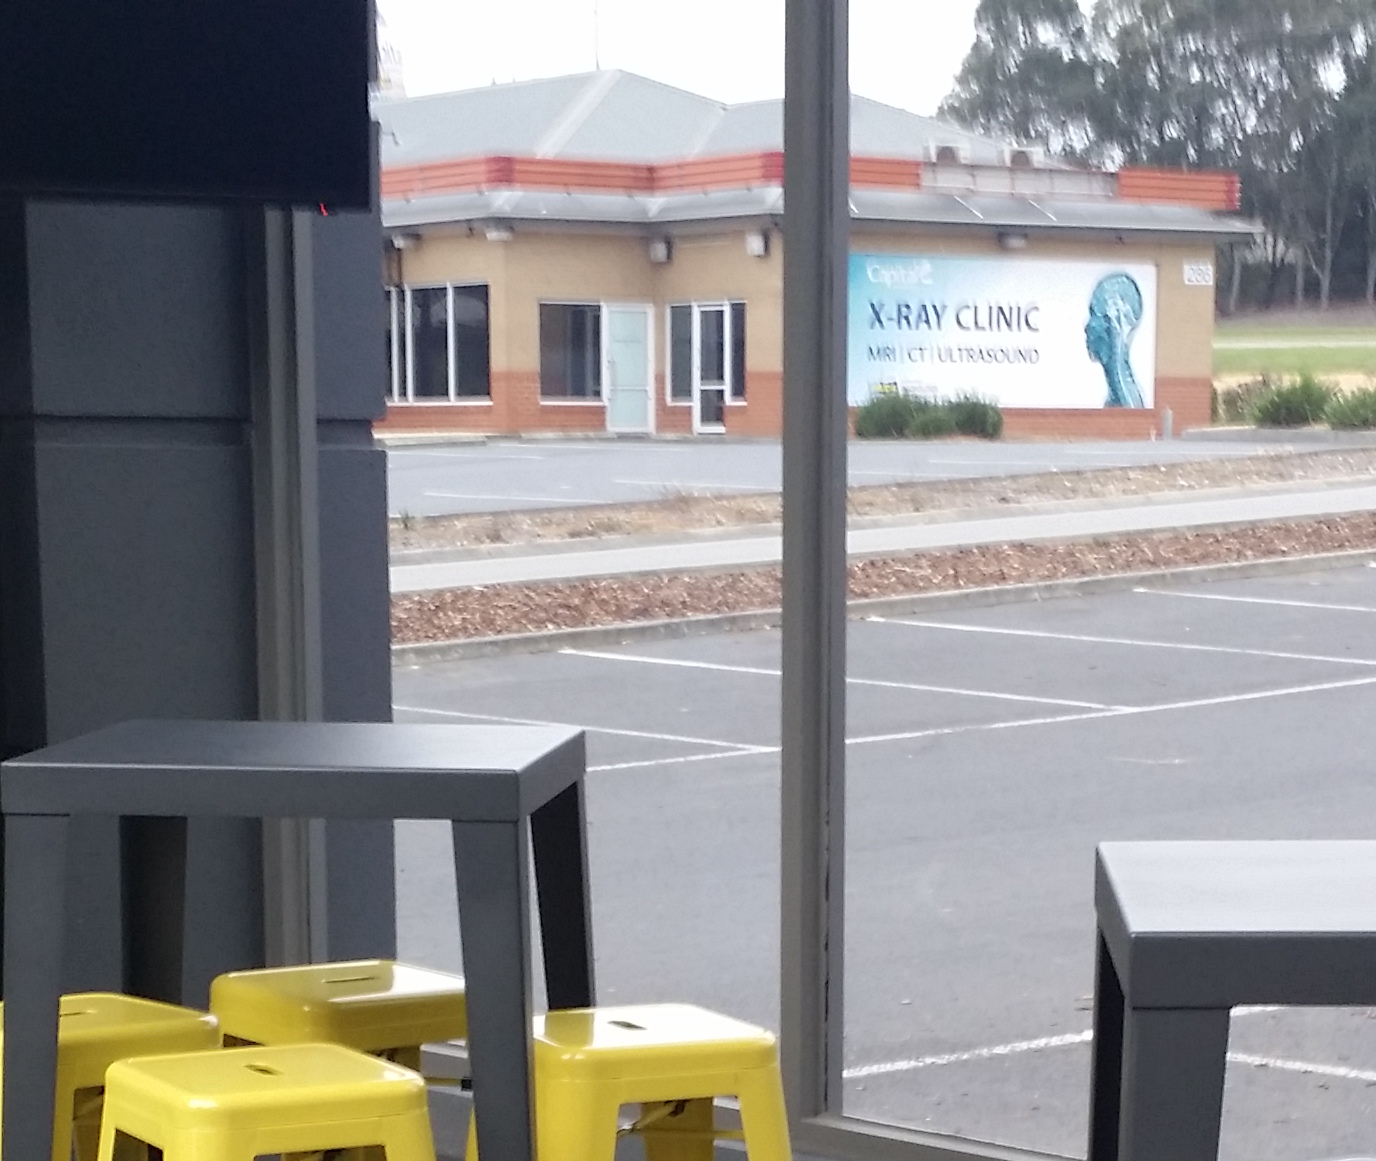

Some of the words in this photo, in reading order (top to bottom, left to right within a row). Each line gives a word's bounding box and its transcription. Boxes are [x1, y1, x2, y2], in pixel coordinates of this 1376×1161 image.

[869, 302, 947, 331] X-RAY
[955, 303, 1040, 332] CLINIC
[867, 346, 896, 362] MRI
[907, 347, 927, 363] CT
[937, 346, 1040, 364] ULTRASOUND
